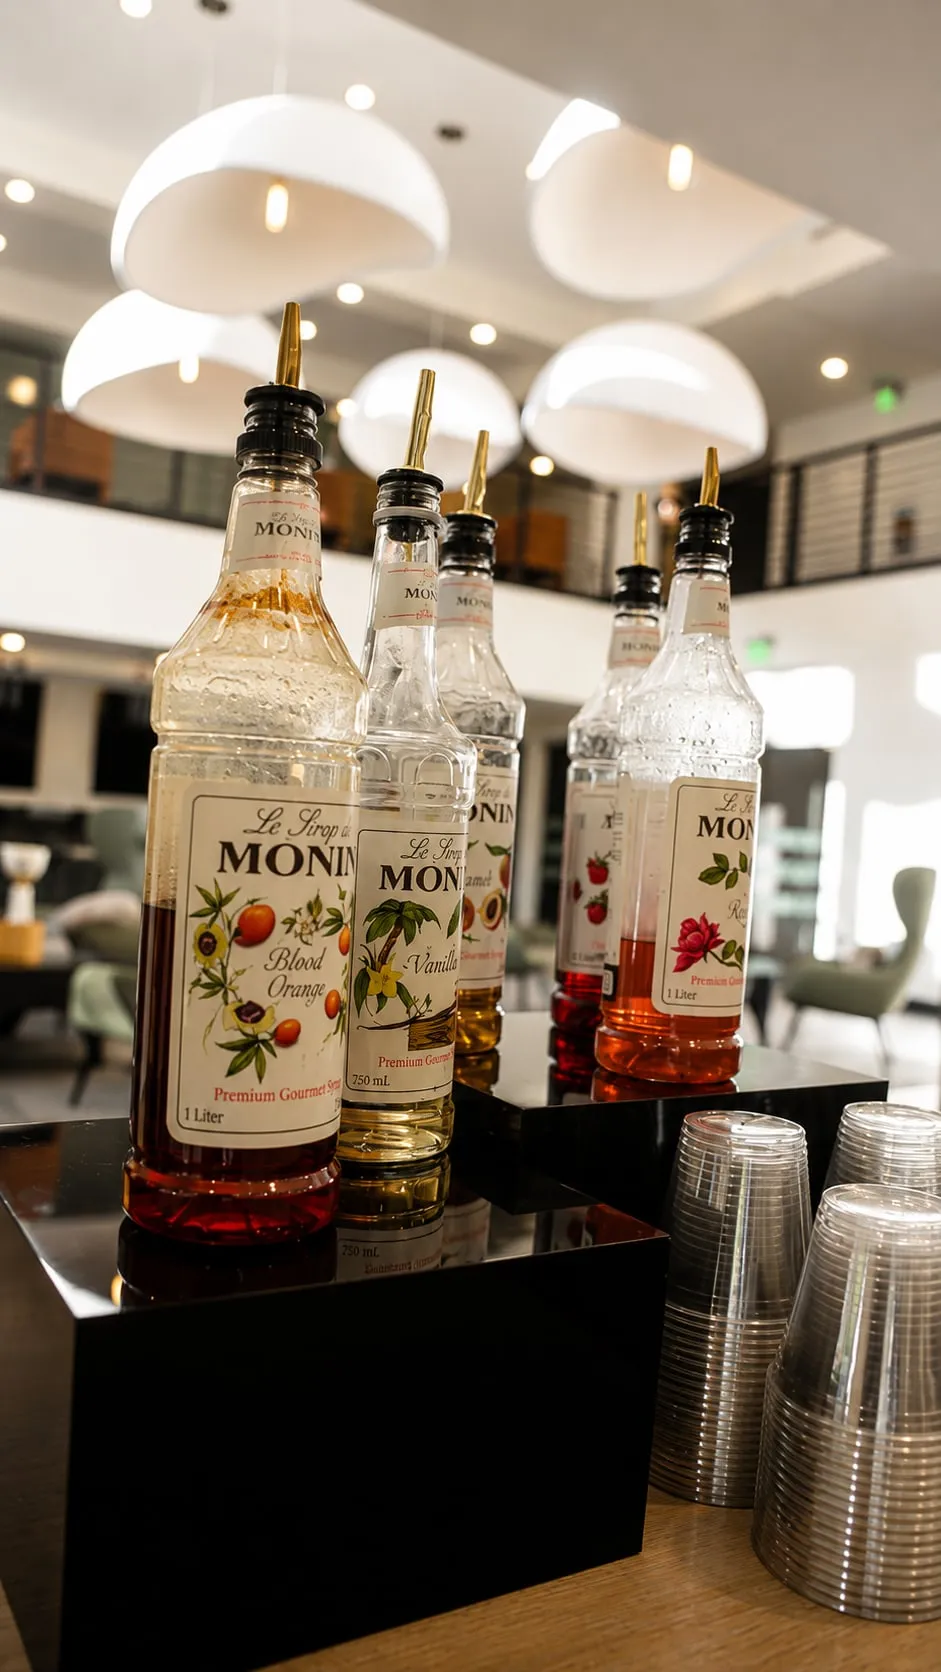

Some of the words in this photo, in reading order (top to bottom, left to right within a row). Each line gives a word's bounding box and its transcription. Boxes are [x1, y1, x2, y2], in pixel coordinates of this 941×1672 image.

[715, 793, 738, 812] Le
[243, 807, 284, 835] Le
[288, 808, 338, 845] Sirop
[400, 838, 430, 859] Le
[263, 945, 327, 971] Blood
[691, 975, 728, 986] Premium
[267, 973, 326, 1008] Orange
[675, 988, 697, 1001] Liter
[378, 1056, 423, 1068] Premium
[352, 1074, 370, 1086] 750
[214, 1087, 276, 1103] Premium
[279, 1084, 326, 1101] Gourmet
[184, 1107, 190, 1121] 1
[194, 1108, 224, 1124] Liter
